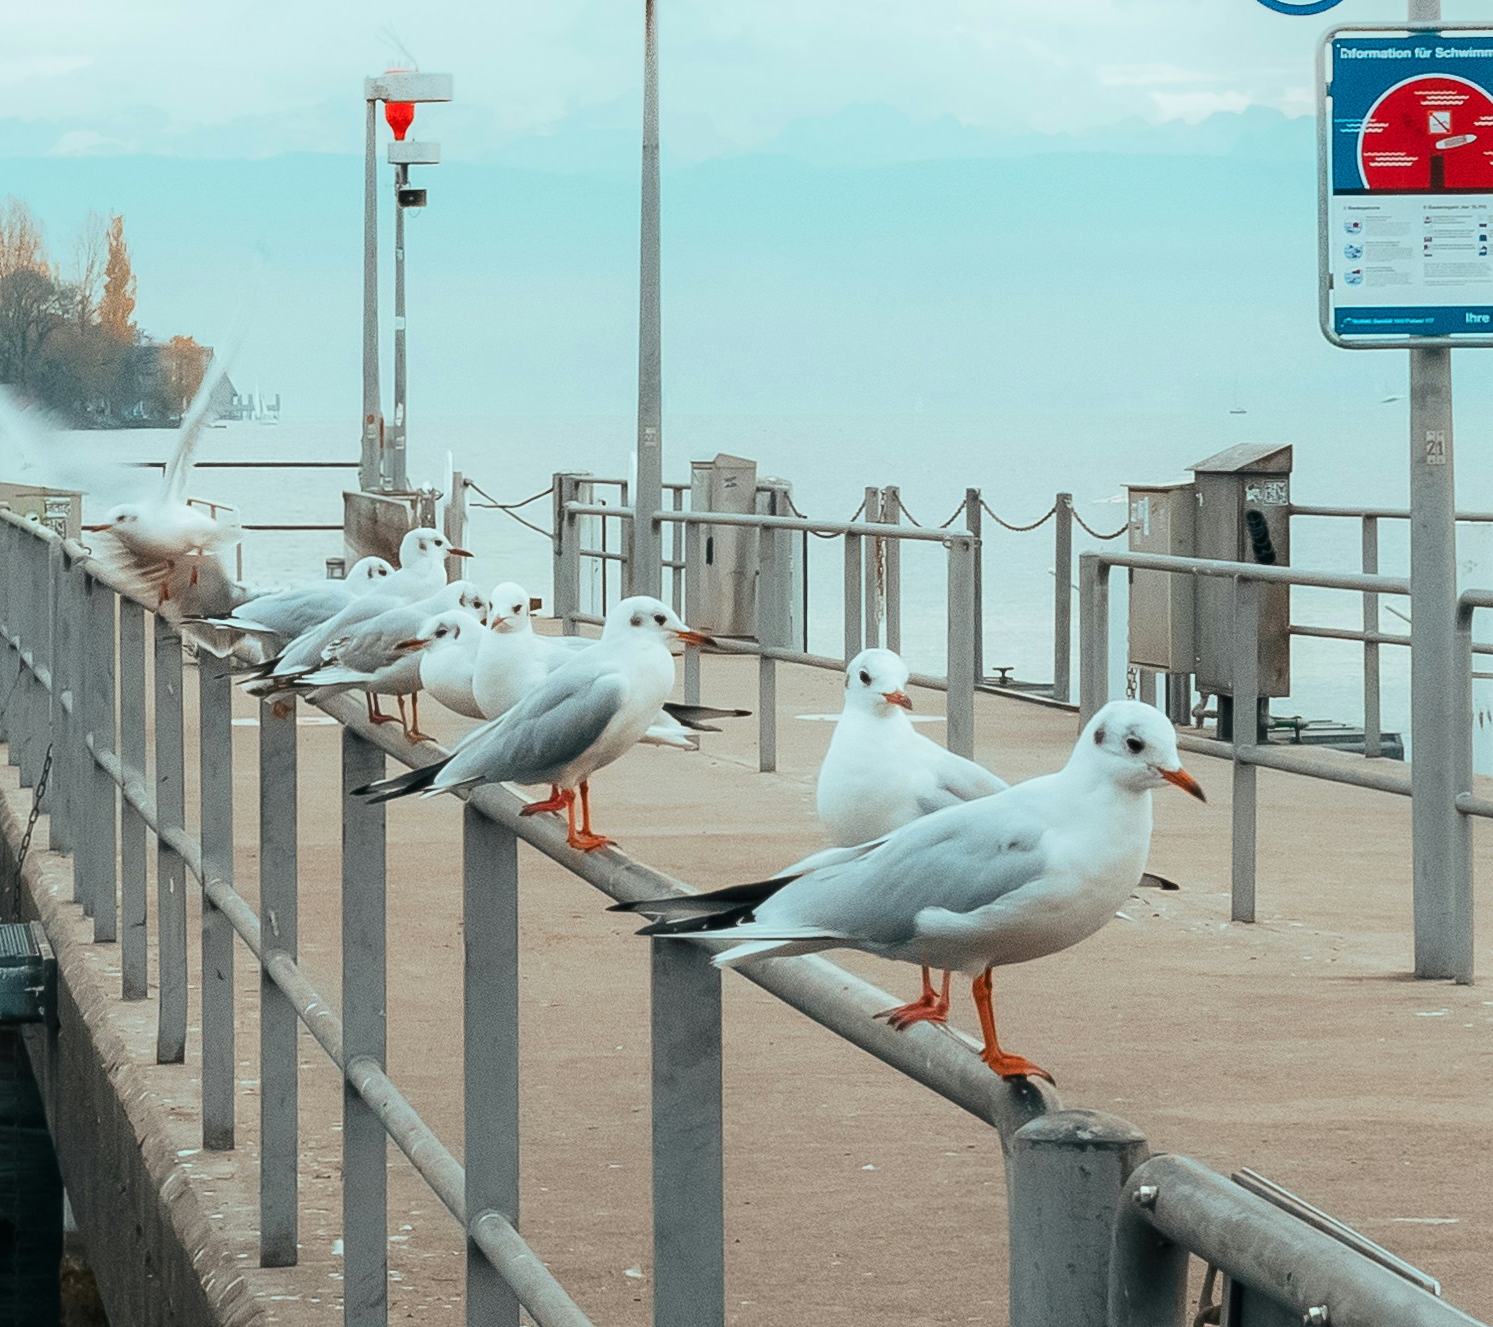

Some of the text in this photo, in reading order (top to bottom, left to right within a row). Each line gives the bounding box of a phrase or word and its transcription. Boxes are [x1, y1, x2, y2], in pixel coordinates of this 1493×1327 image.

[1340, 47, 1412, 59] Information
[1415, 47, 1431, 59] für
[1465, 312, 1490, 324] Ihre
